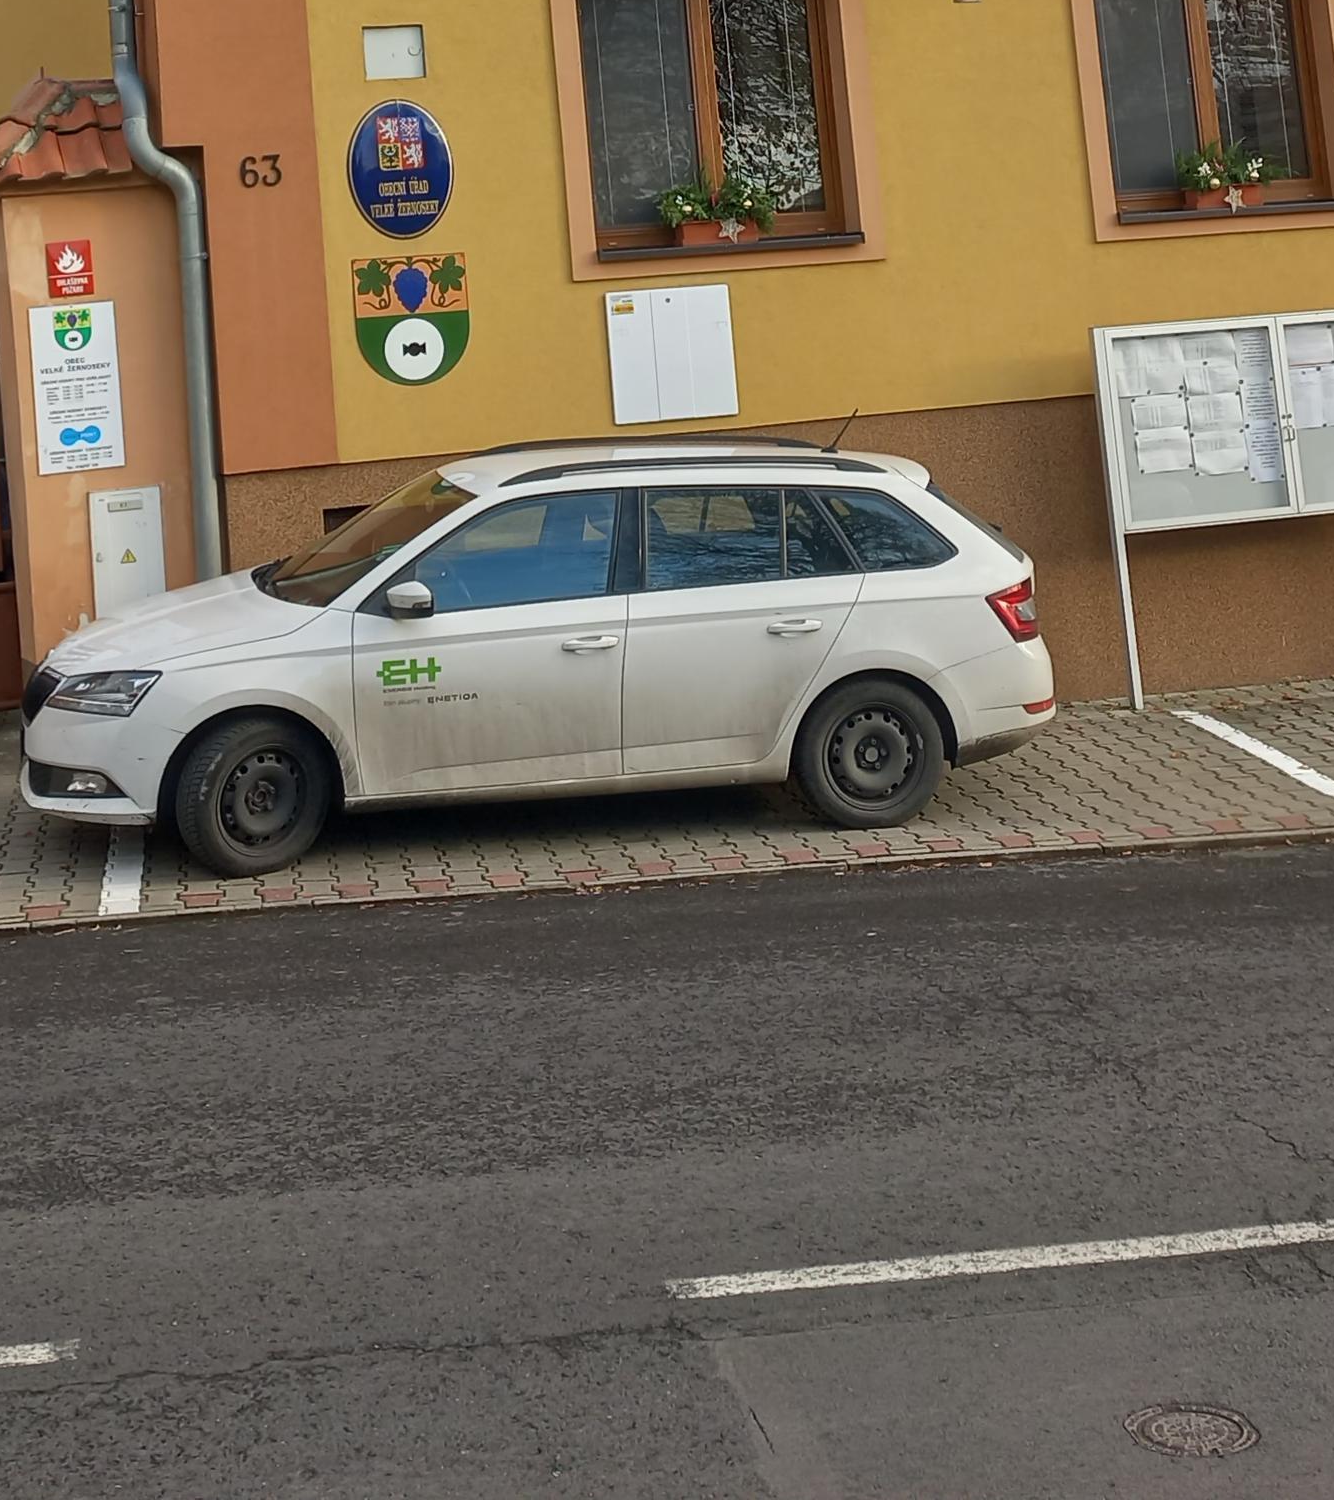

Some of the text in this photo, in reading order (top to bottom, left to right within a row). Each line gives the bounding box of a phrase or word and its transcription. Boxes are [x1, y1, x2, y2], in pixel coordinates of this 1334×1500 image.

[239, 153, 283, 189] 63
[378, 176, 429, 197] OBECNÍ ÚŘAD
[370, 199, 439, 218] VELKÉ ŽERNOSEKY
[39, 361, 112, 375] VELKÉ ŽERNOSEKY
[64, 356, 86, 366] OBEC
[376, 657, 441, 686] EH
